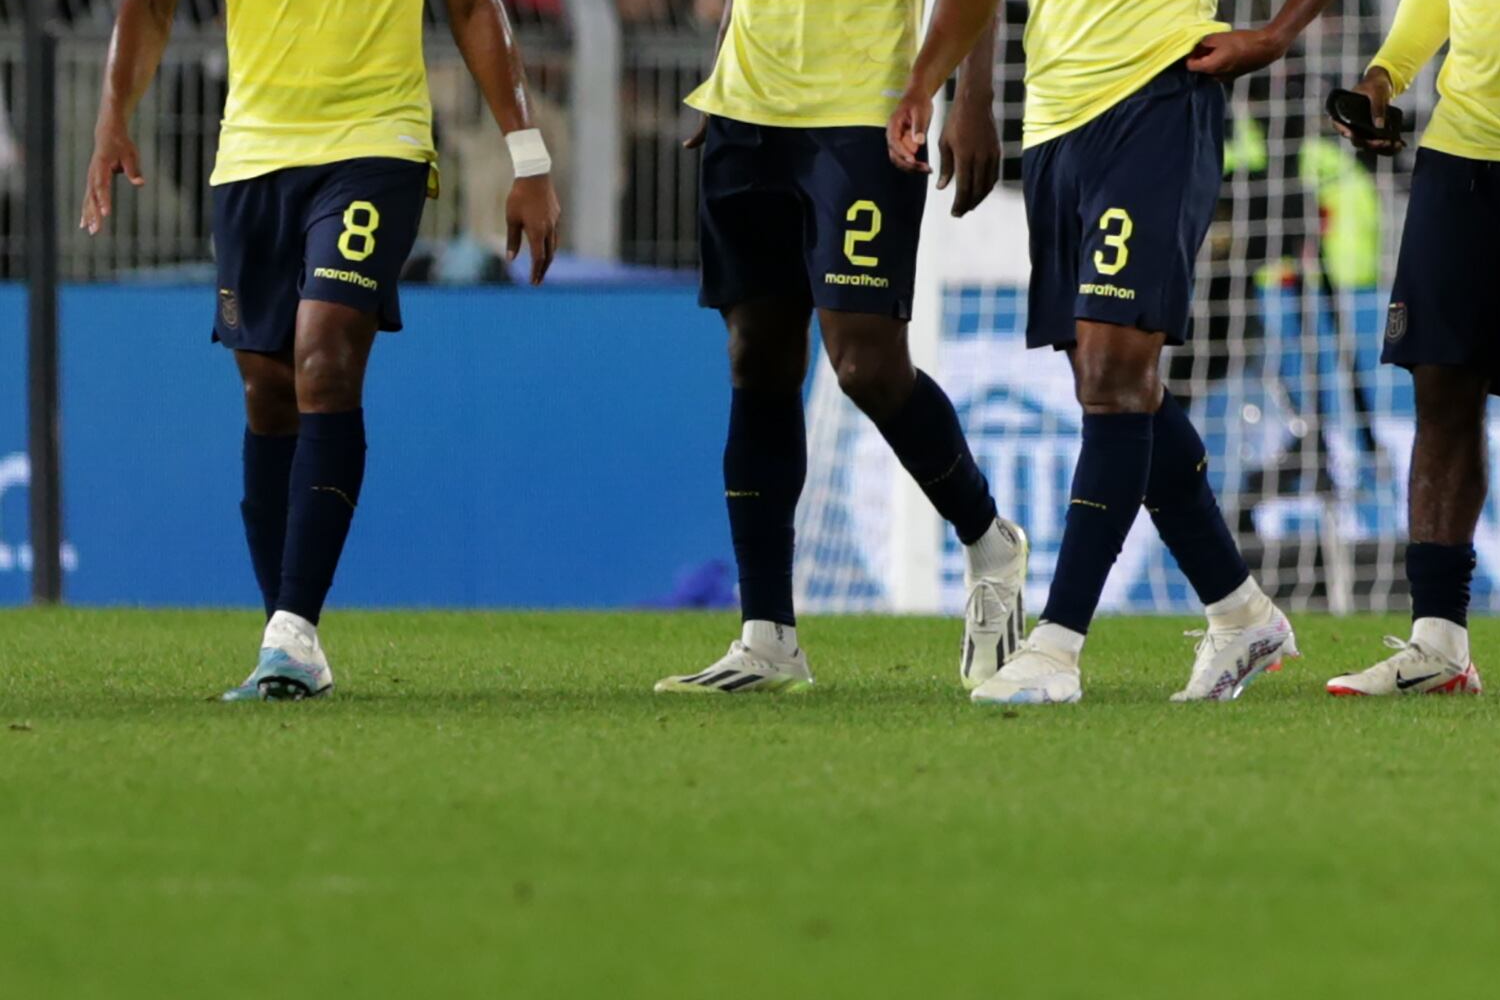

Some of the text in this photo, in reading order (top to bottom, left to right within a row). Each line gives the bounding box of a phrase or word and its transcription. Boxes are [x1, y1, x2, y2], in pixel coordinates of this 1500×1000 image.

[337, 200, 380, 261] 8
[843, 199, 882, 267] 2
[1093, 207, 1133, 276] 3
[314, 266, 378, 291] marathon
[825, 273, 889, 288] marathon
